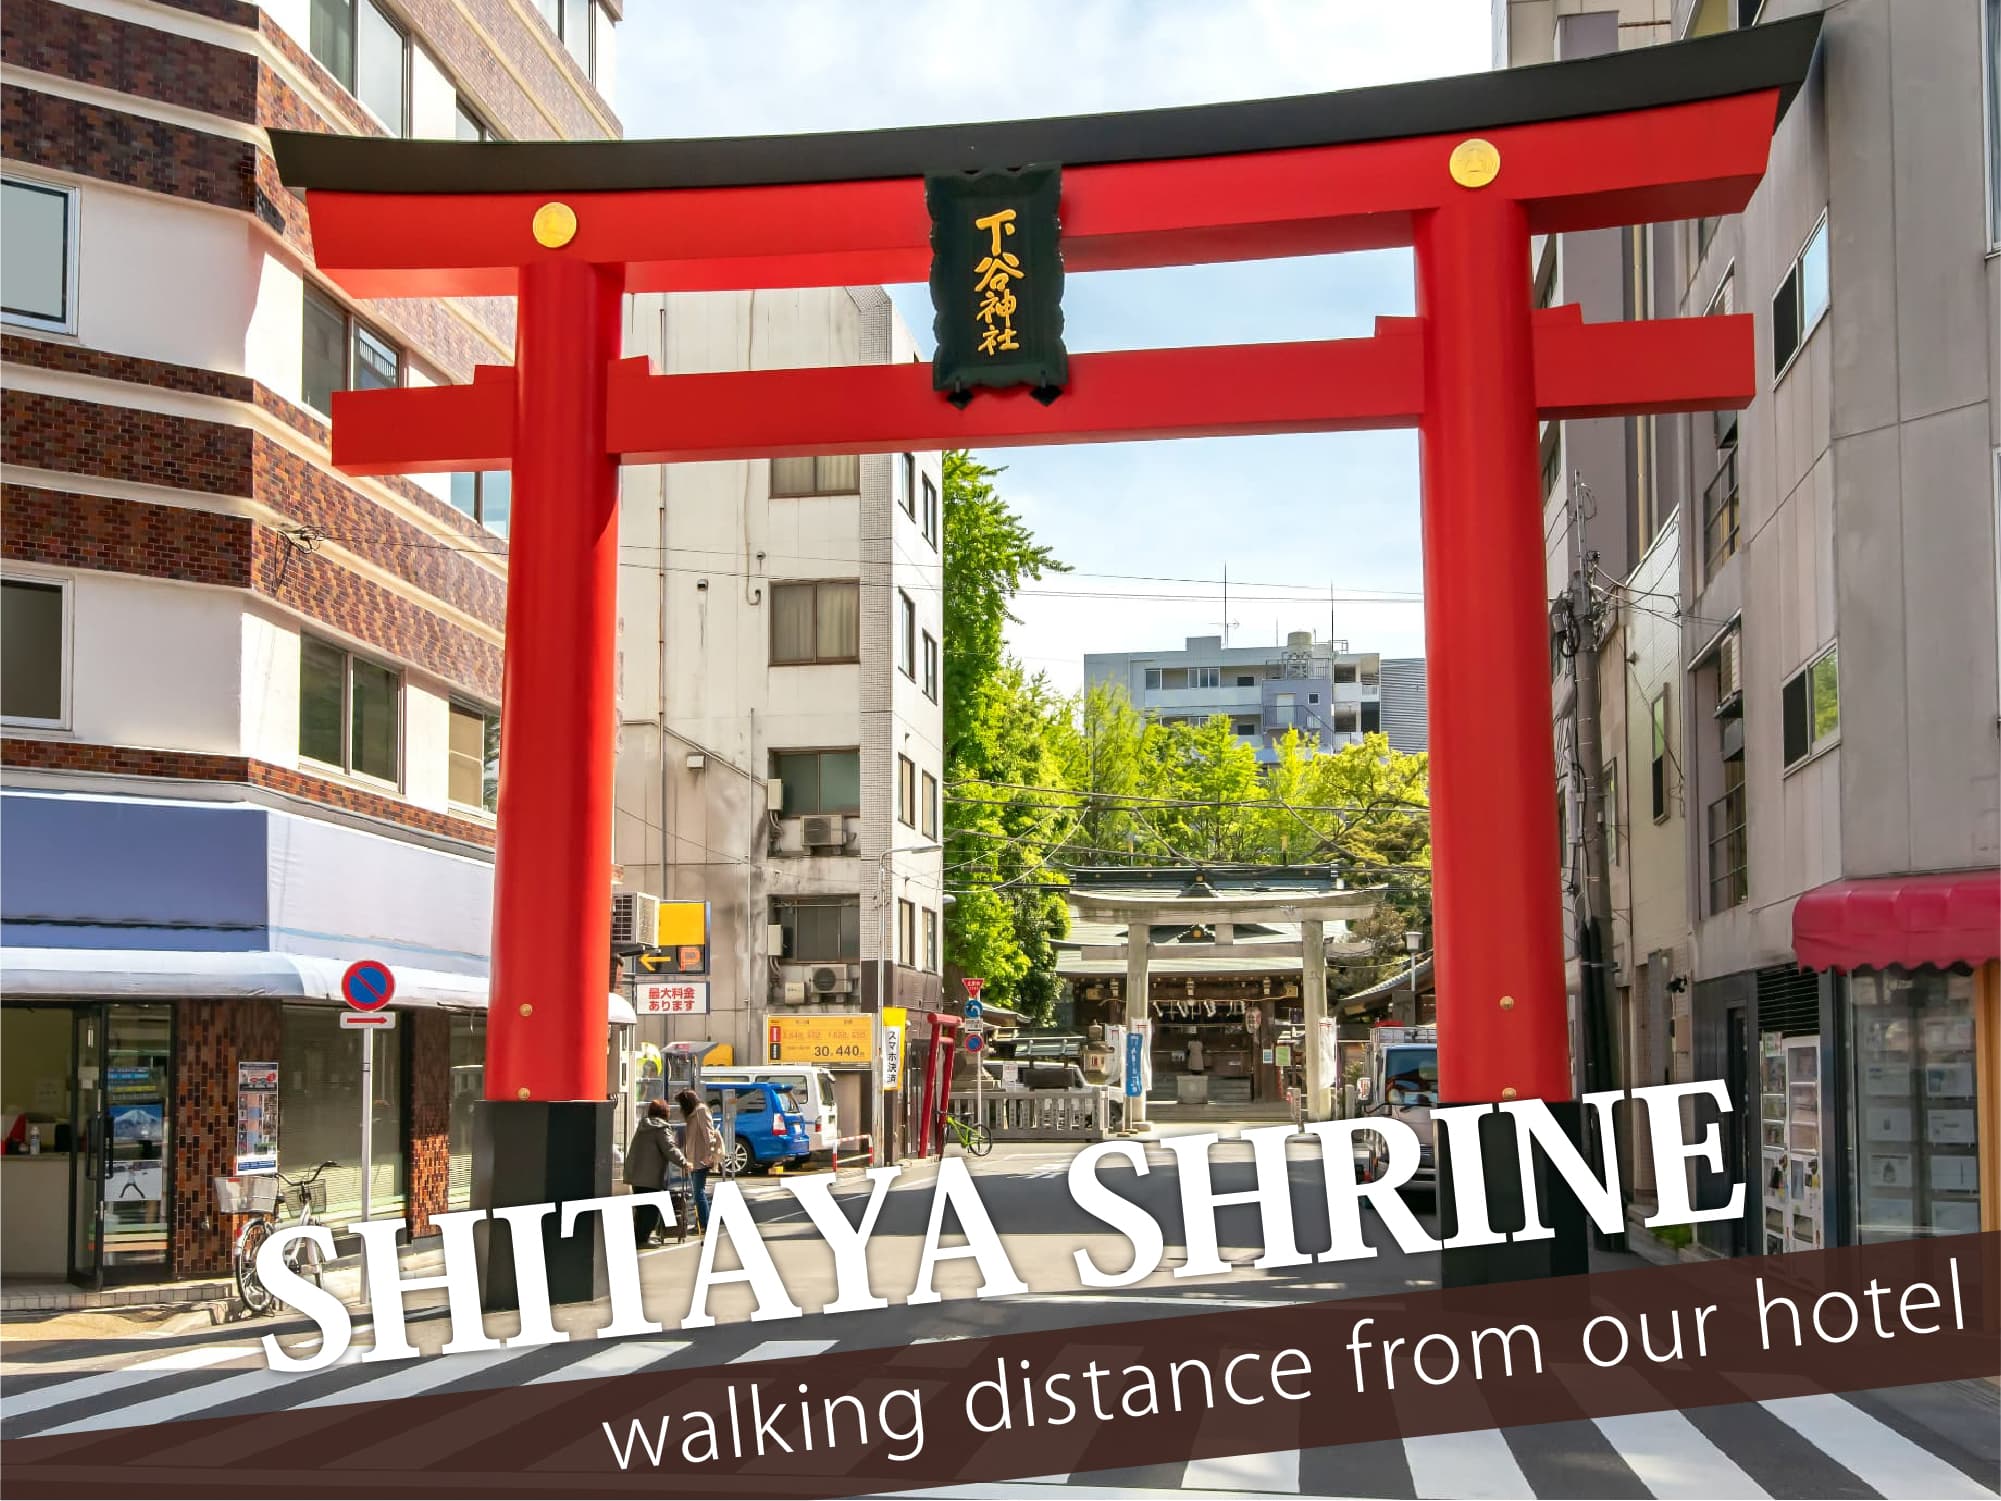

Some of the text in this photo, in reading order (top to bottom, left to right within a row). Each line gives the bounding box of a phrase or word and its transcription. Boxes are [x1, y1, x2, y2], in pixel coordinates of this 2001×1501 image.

[973, 208, 1025, 357] 下谷神社
[679, 947, 701, 972] P
[648, 987, 696, 999] 最大料金
[648, 1000, 696, 1012] あります
